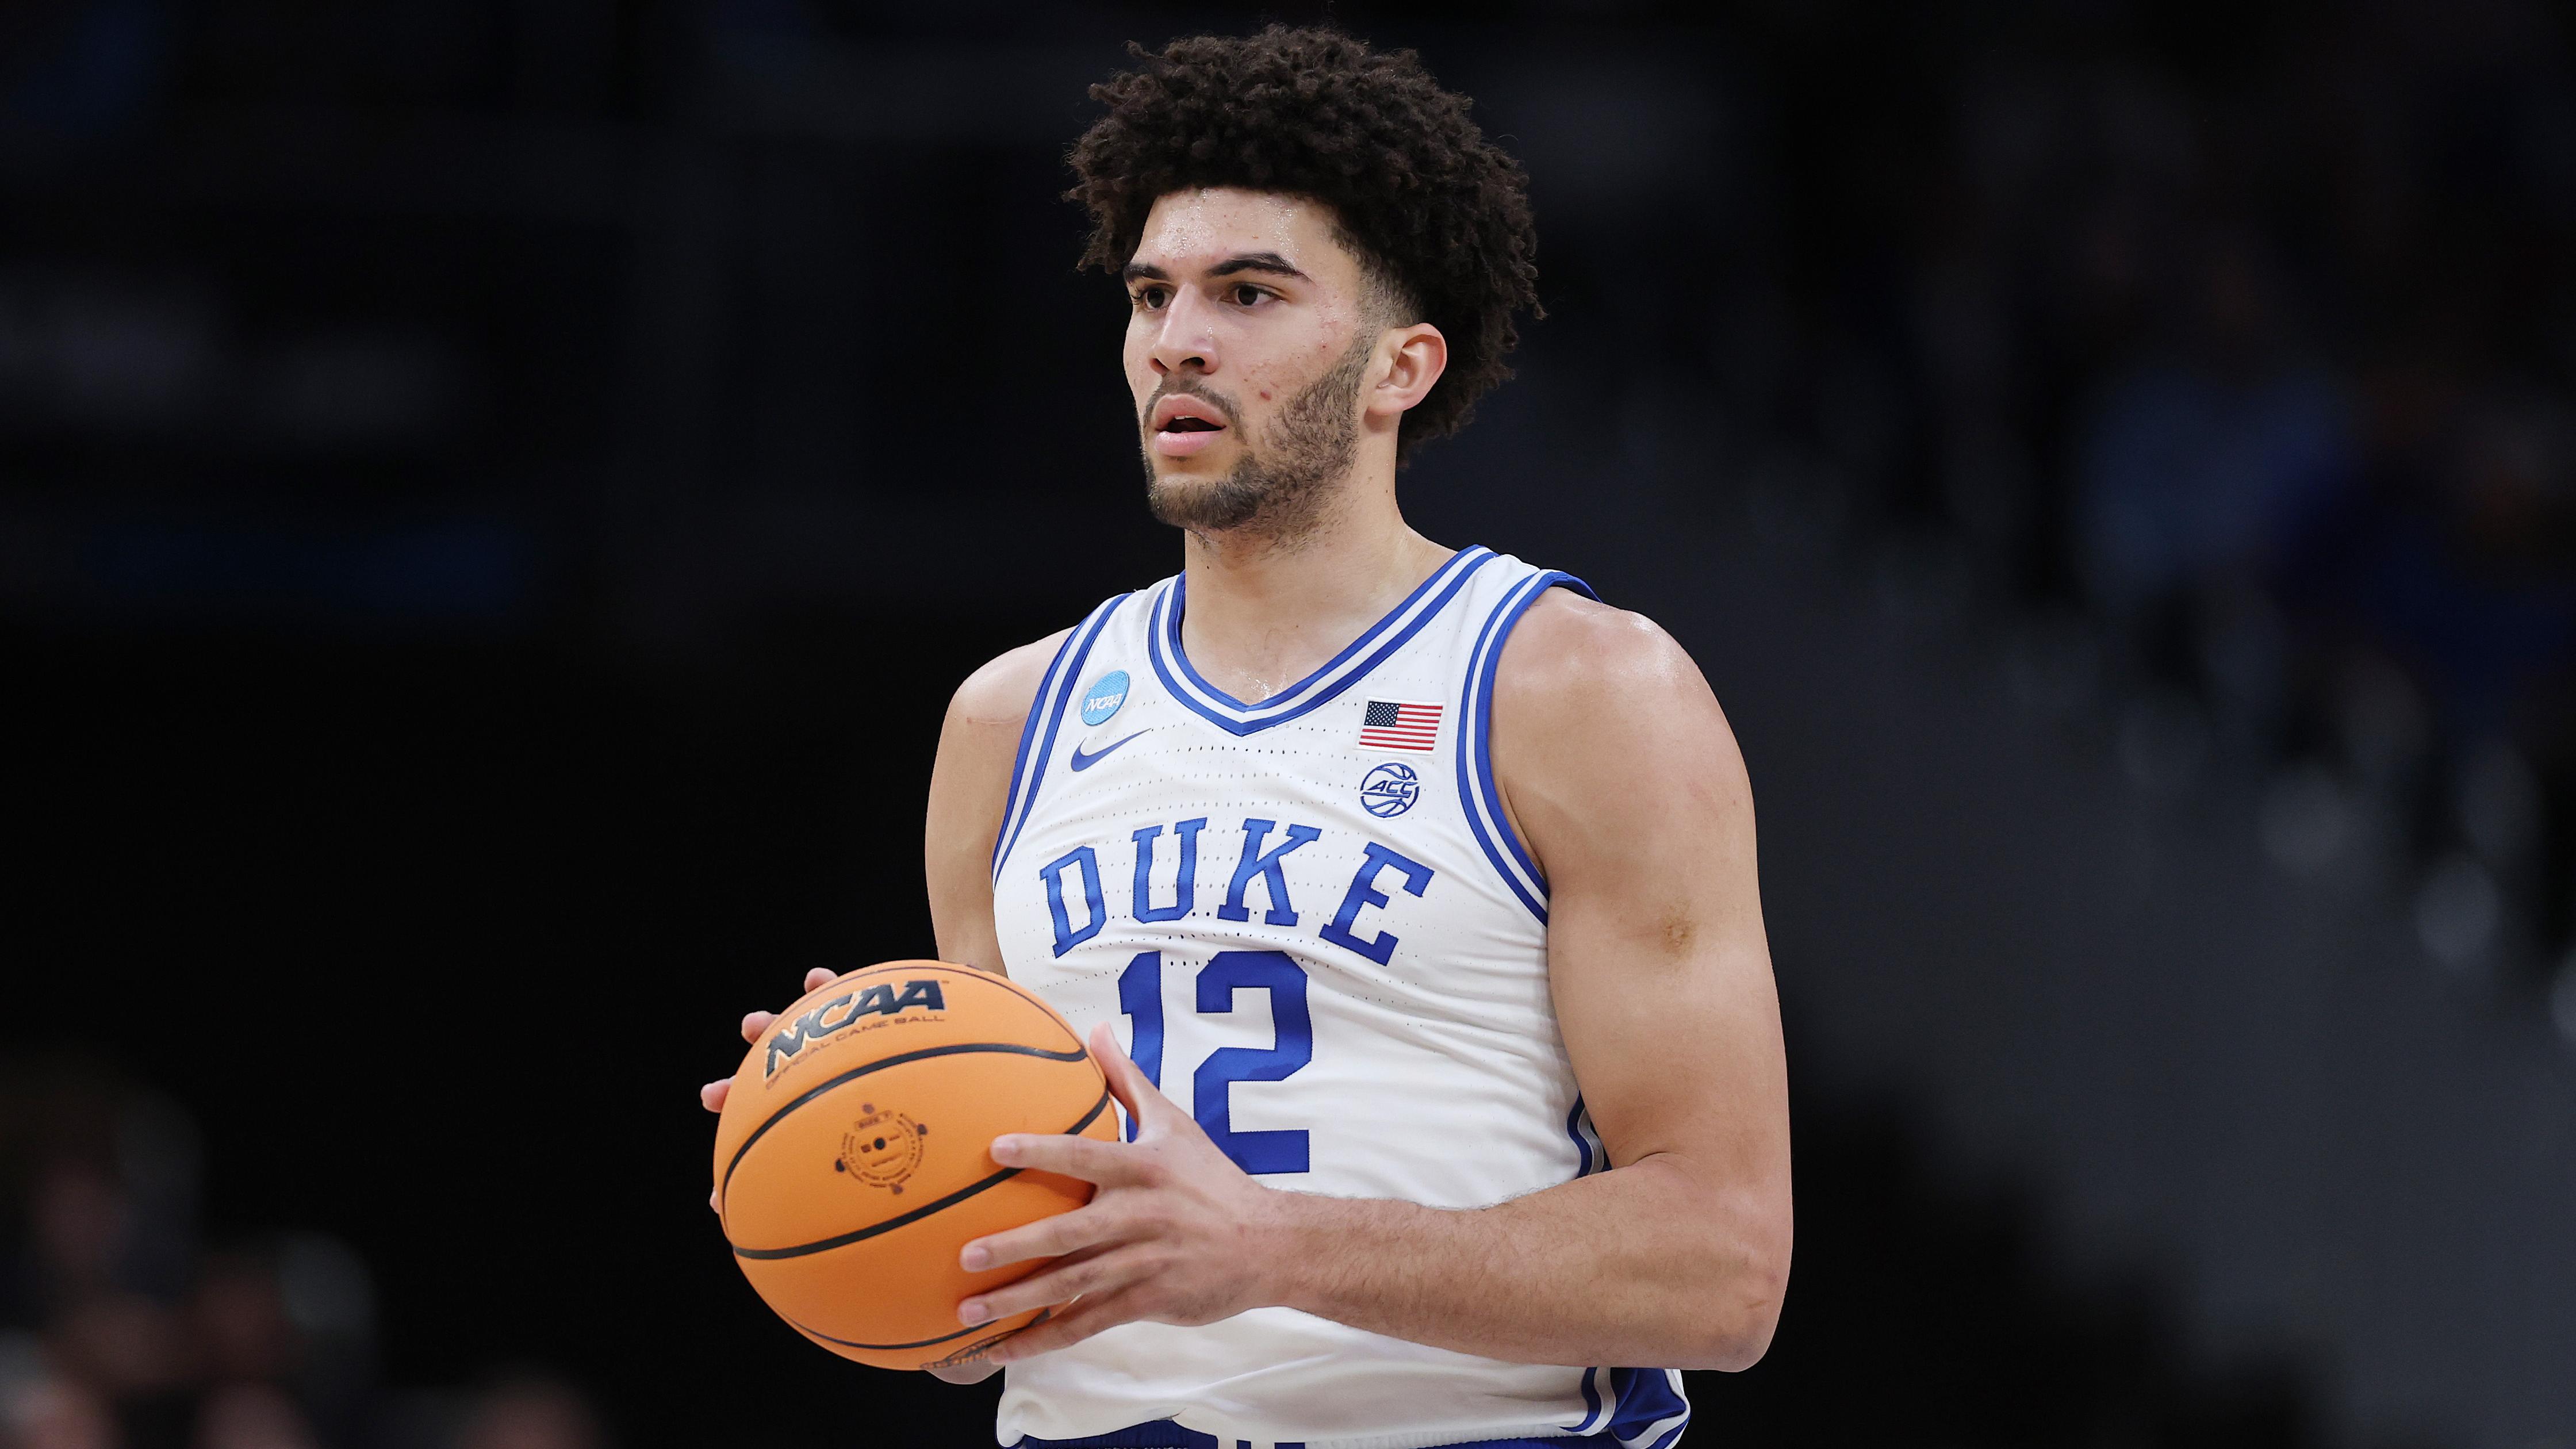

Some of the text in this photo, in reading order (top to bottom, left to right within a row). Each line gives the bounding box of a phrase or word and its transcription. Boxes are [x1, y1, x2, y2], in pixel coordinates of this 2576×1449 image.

[1084, 693, 1122, 713] NCAA
[1367, 780, 1418, 794] ACC
[1040, 816, 1435, 965] DUKE
[764, 979, 945, 1081] NCAA
[894, 1015, 944, 1024] BALL
[1118, 950, 1312, 1175] 12
